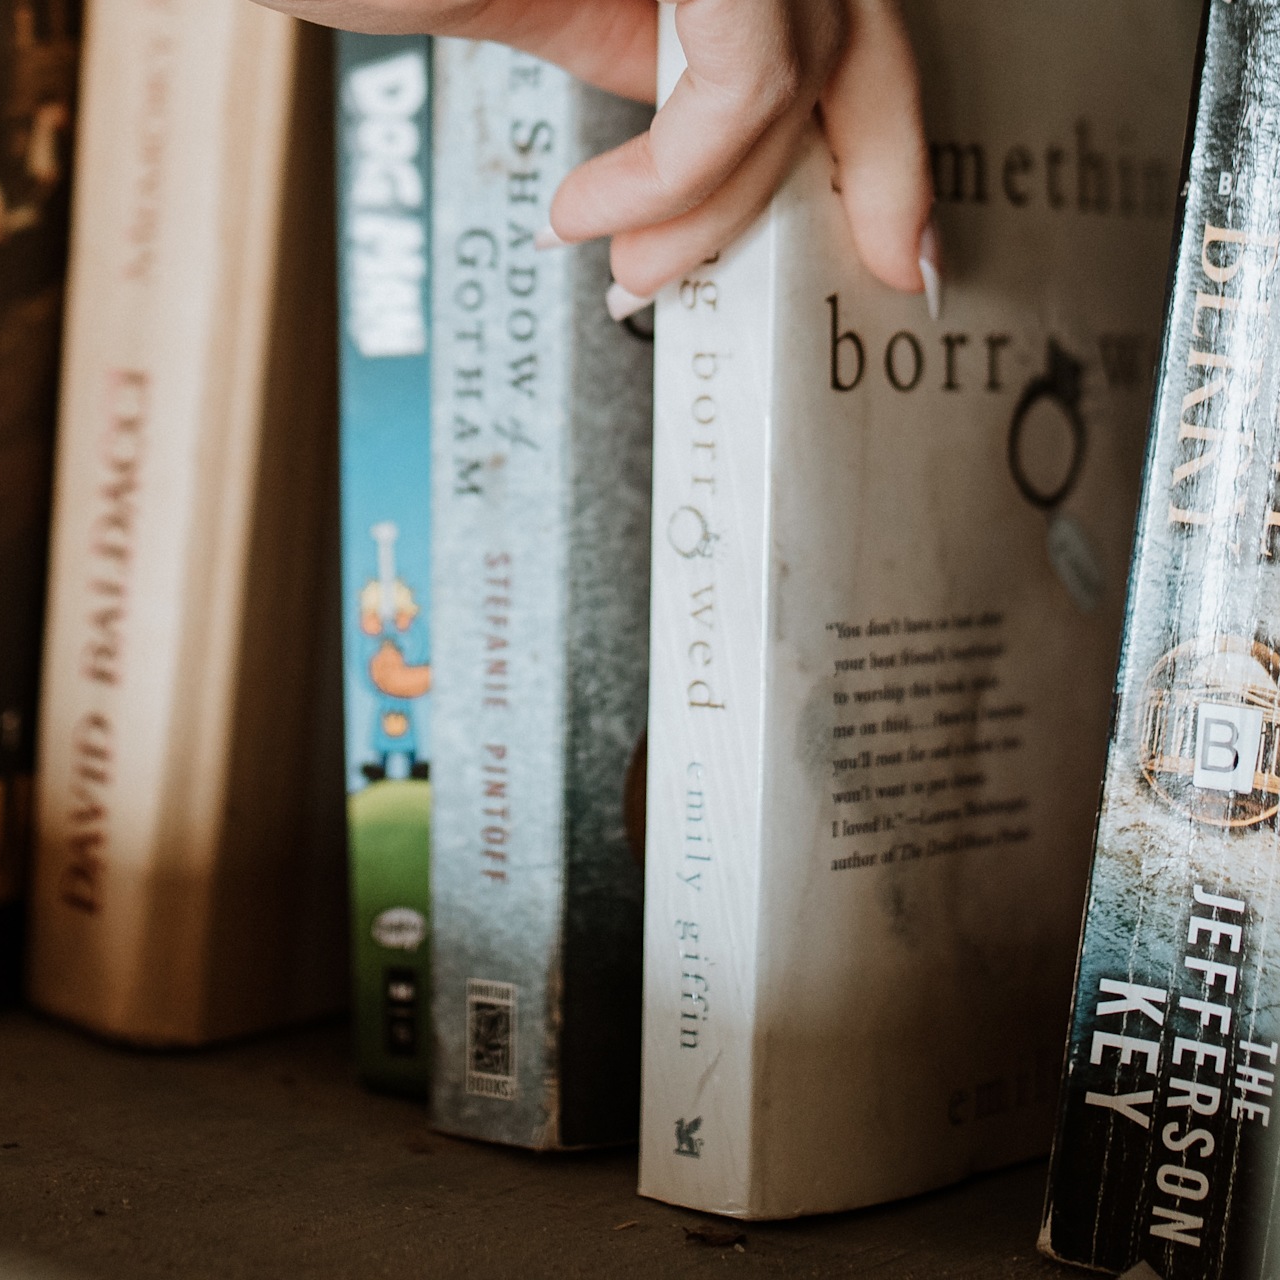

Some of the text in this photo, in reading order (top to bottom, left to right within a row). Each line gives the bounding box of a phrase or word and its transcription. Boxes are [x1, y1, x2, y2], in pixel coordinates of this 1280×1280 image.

[344, 49, 429, 359] DOG MAN
[506, 118, 555, 399] SHADOW
[452, 225, 499, 498] GOTHAM
[80, 366, 151, 689] BALDACCI
[479, 550, 513, 887] STEFANIE PINTOFF
[833, 657, 866, 678] your
[833, 691, 849, 706] to
[853, 682, 906, 705] worship
[833, 724, 856, 740] me
[860, 723, 878, 736] on
[61, 710, 118, 917] DAVID
[676, 760, 713, 893] emily
[830, 850, 878, 872] author
[831, 819, 839, 839] I
[841, 815, 881, 837] loved
[675, 918, 717, 1051] giffin
[1084, 976, 1169, 1131] KEY
[1147, 883, 1247, 1249] JEFFERSON
[1230, 1039, 1279, 1128] THE
